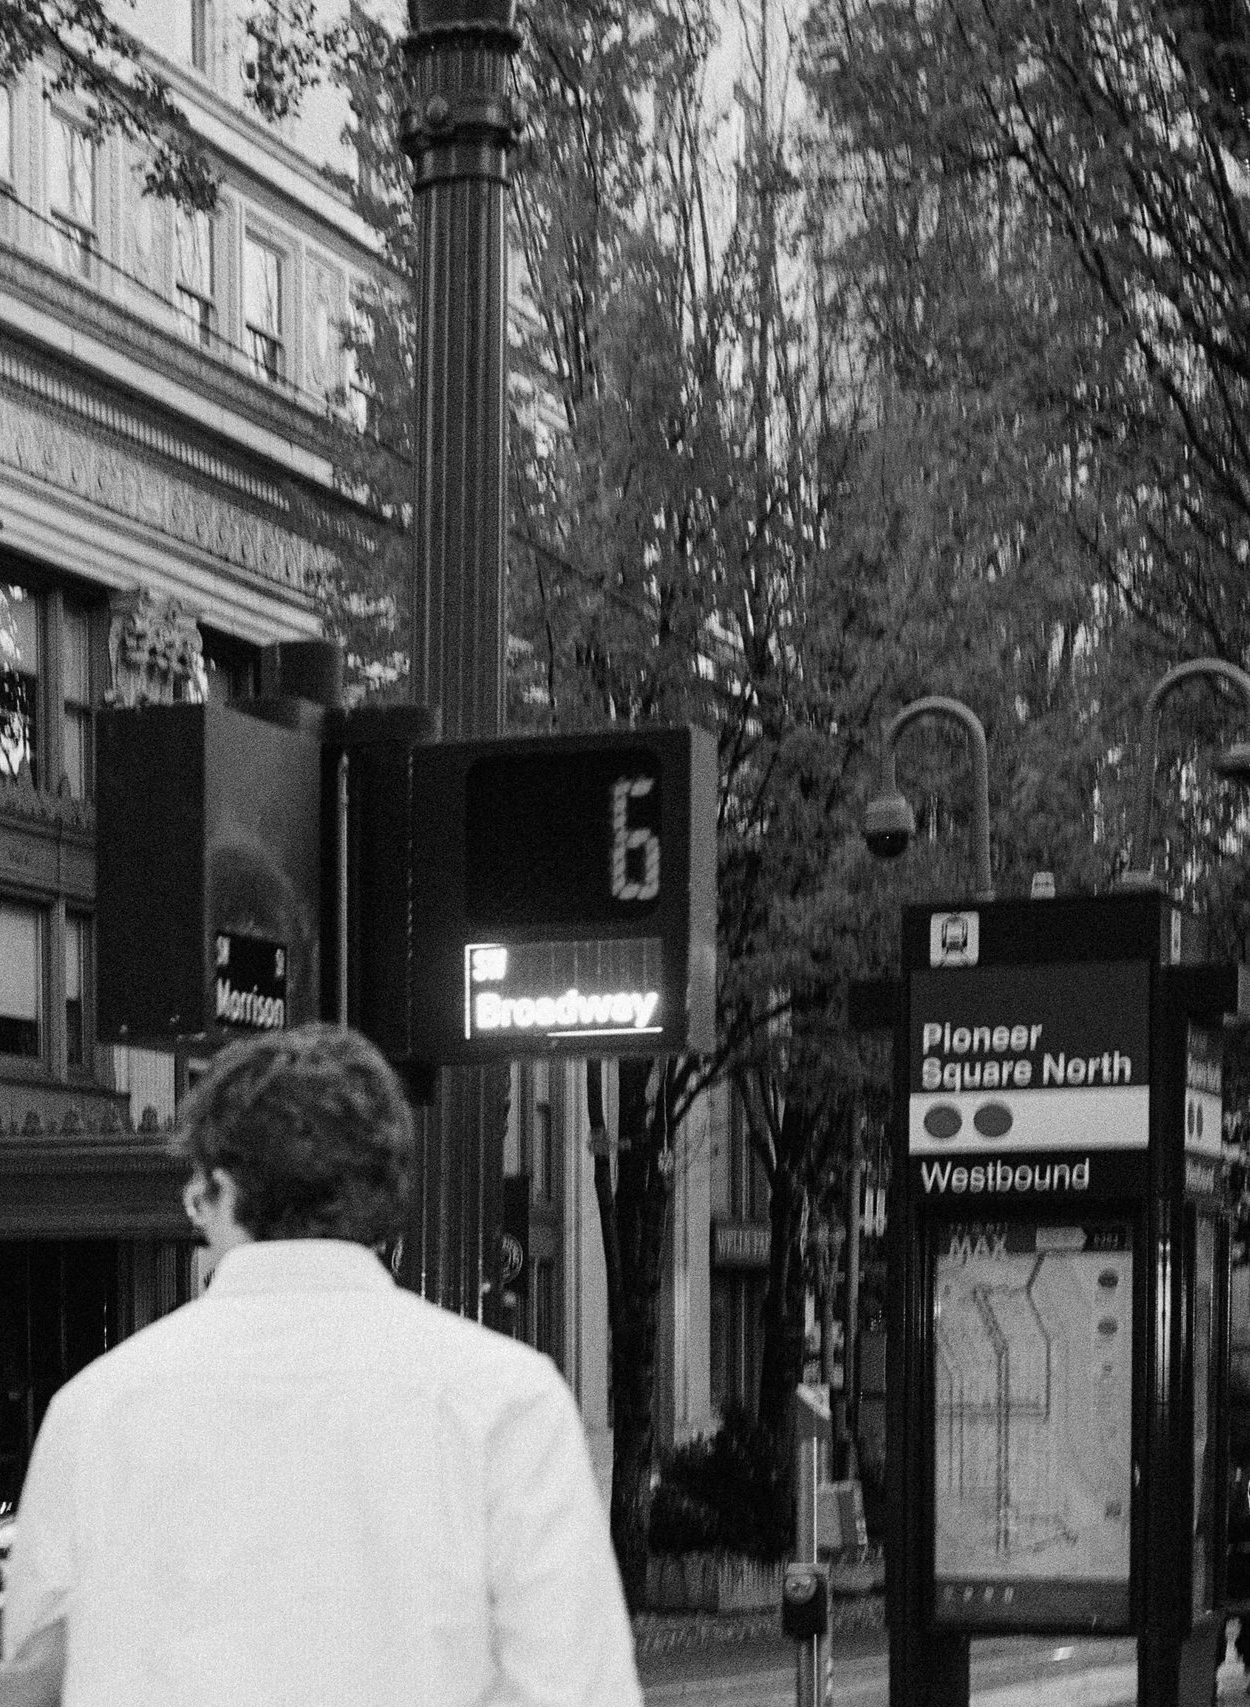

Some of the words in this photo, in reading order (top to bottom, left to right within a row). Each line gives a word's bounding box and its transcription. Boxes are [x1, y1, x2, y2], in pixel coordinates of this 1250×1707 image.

[612, 777, 659, 898] 6
[216, 978, 285, 1029] Morrison
[474, 988, 659, 1029] Broadway
[922, 1022, 1043, 1055] Pioneer
[921, 1056, 1032, 1092] Square
[1042, 1050, 1132, 1085] North
[920, 1157, 1090, 1193] Westbound
